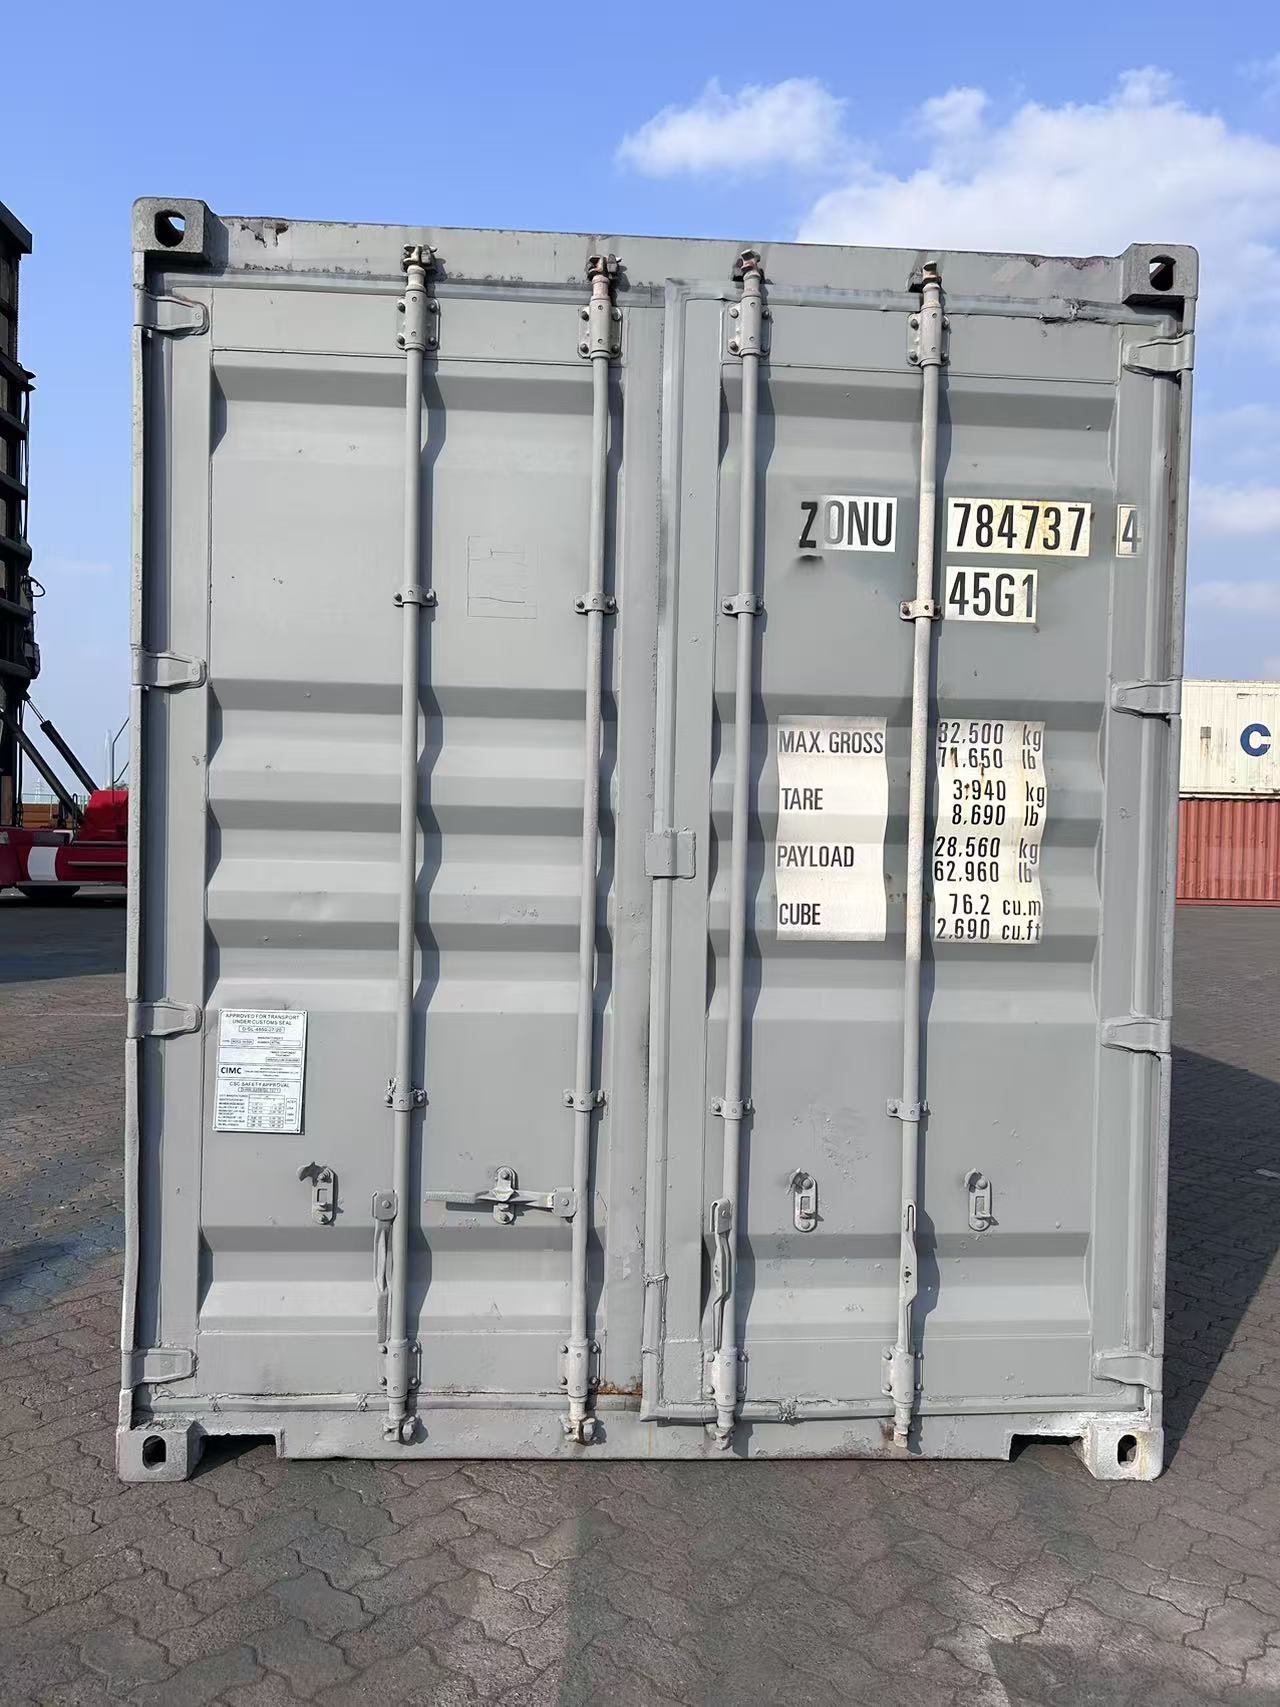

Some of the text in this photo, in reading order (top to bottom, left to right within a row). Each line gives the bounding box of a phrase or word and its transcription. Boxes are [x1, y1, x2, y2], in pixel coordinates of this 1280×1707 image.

[799, 500, 1142, 553] ZONU 784737 4
[949, 571, 1034, 618] 45G1
[779, 730, 884, 754] MAX. GROSS
[1022, 724, 1042, 752] kg
[1022, 749, 1036, 770] lb
[781, 787, 824, 810] TARE
[1026, 781, 1045, 808] kg
[1024, 805, 1039, 827] lb
[777, 845, 854, 868] PAYLOAD
[1018, 838, 1038, 865] kg
[1018, 862, 1032, 883] lb
[779, 893, 1041, 926] CUBE 76.2 cu.m
[1001, 919, 1041, 940] cu.ft
[220, 1066, 242, 1074] CIMC
